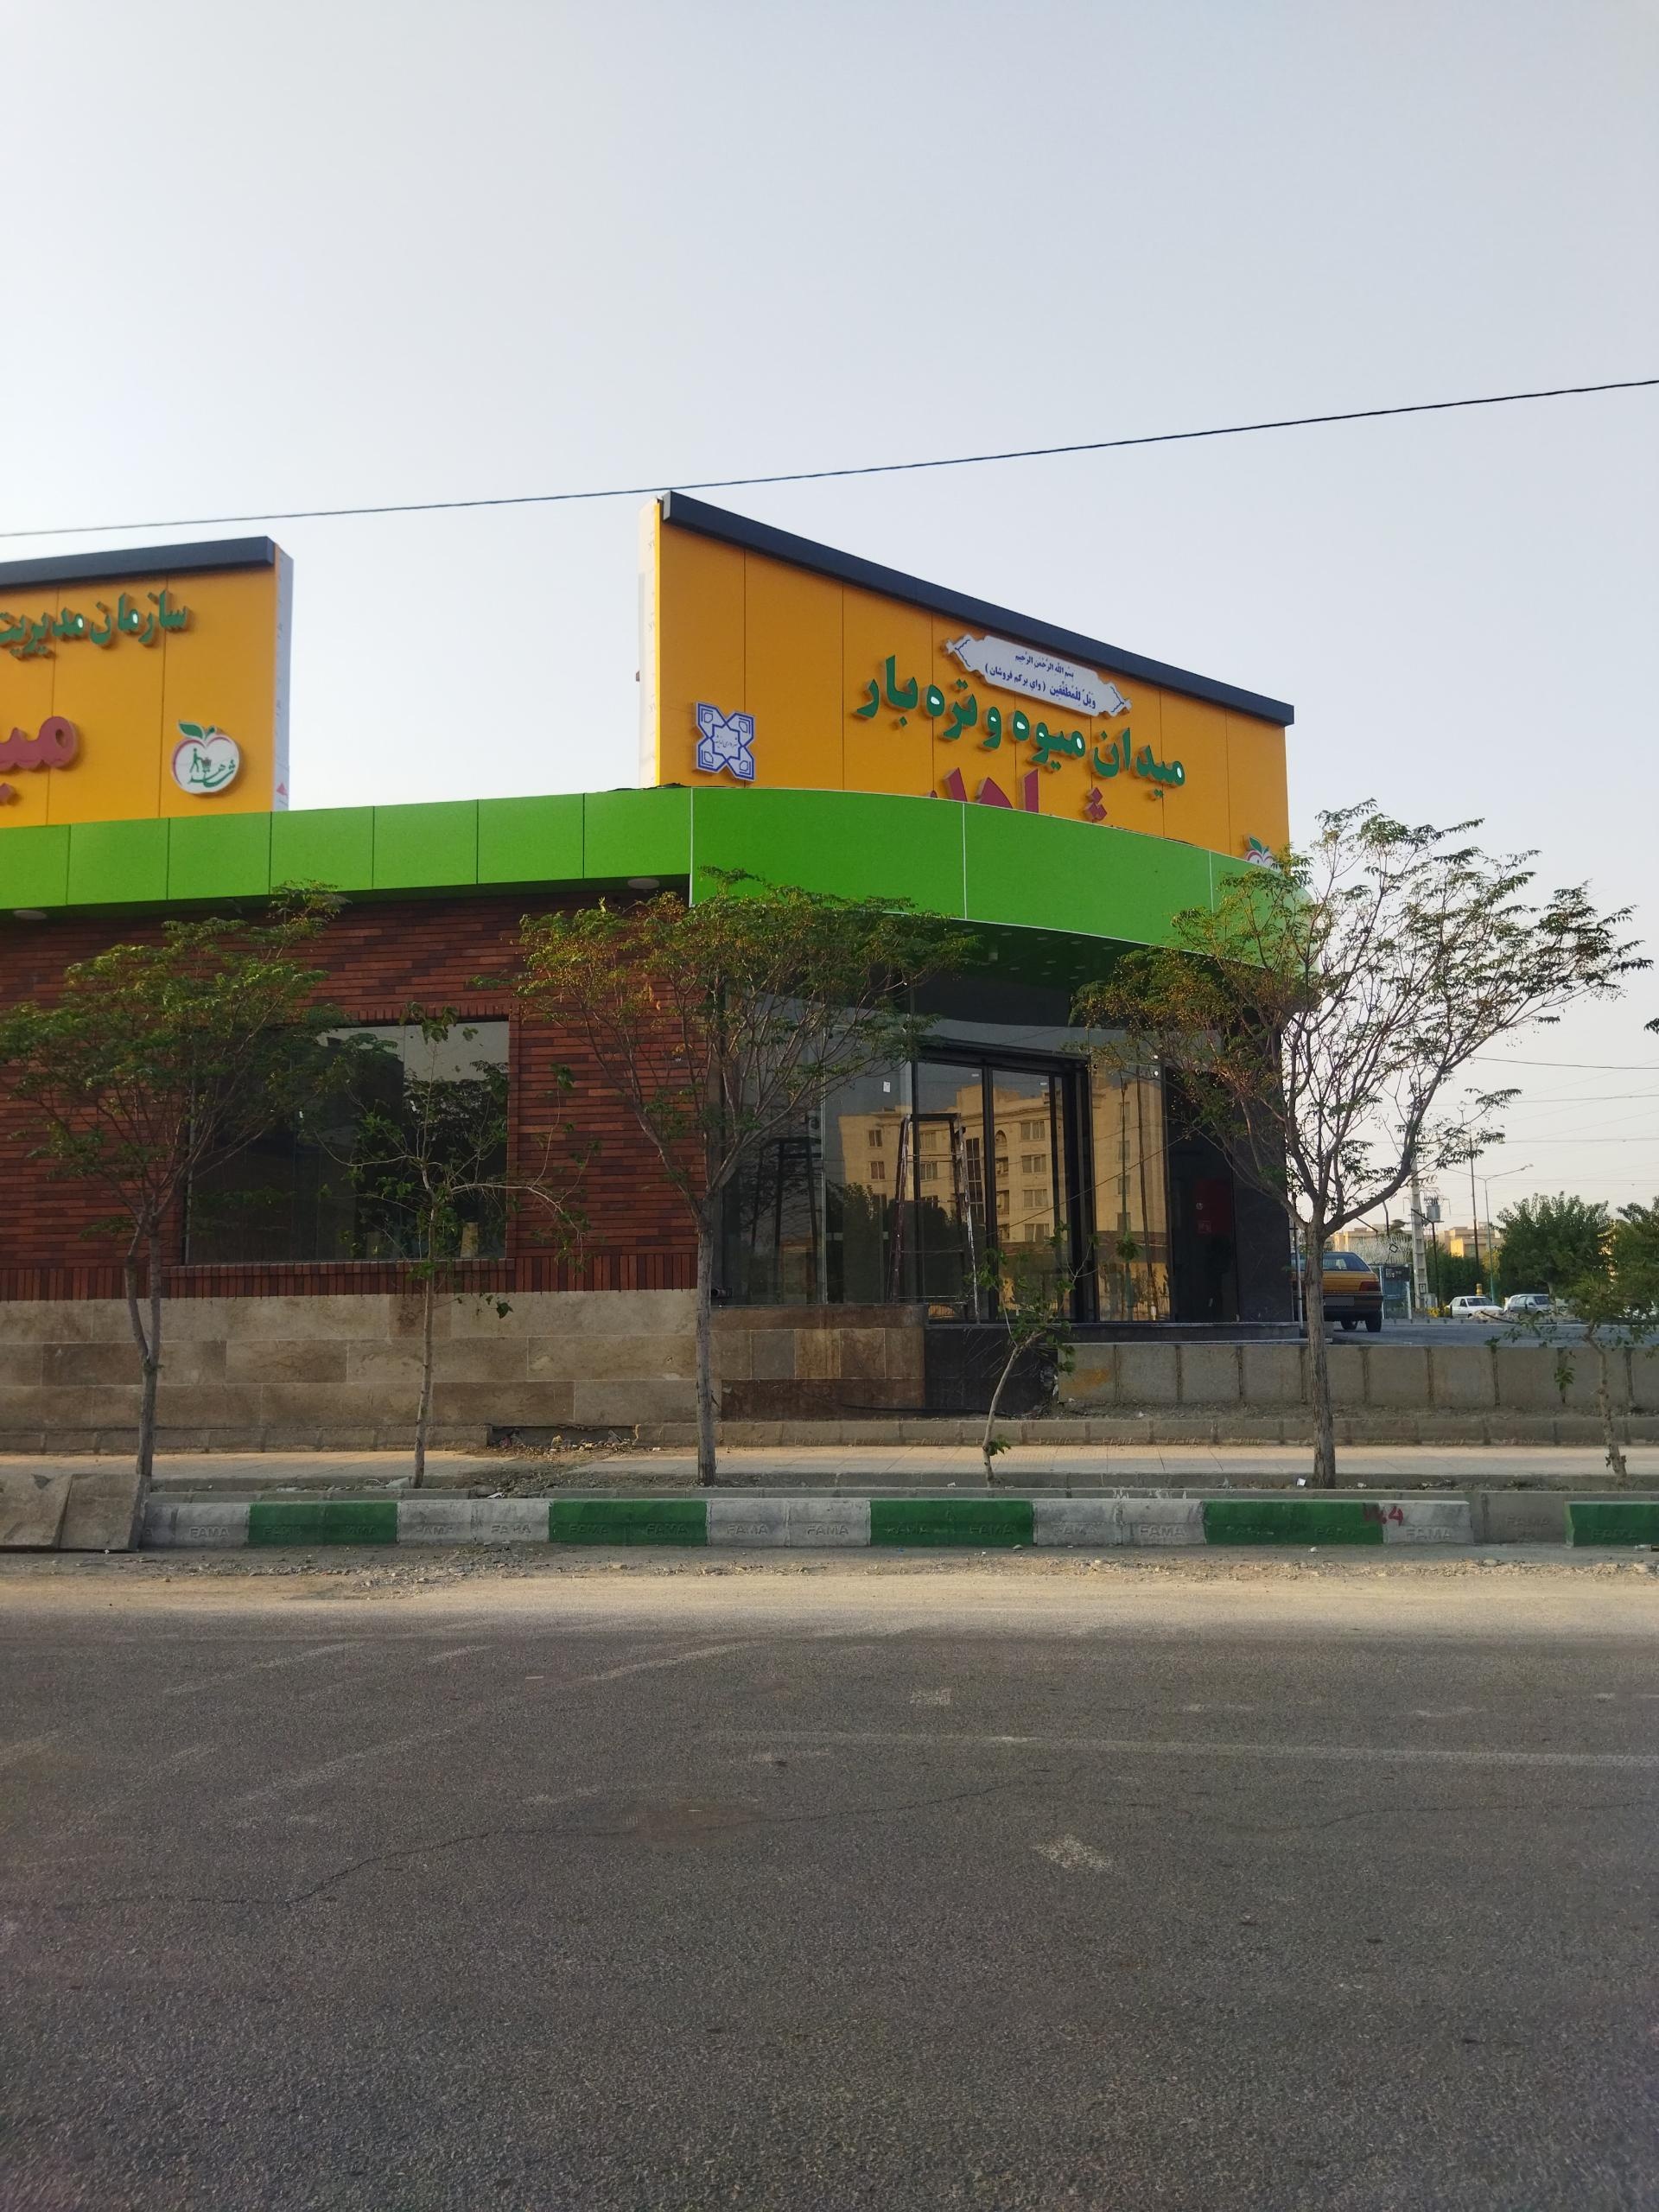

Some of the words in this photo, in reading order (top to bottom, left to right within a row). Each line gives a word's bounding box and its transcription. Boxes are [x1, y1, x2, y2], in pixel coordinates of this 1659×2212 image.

[89, 588, 188, 645] سازمان
[983, 705, 1002, 749] و
[1012, 709, 1086, 771] میوه
[1090, 727, 1186, 798] میدان
[188, 1525, 230, 1538] FAMA
[806, 1523, 850, 1535] FAMA
